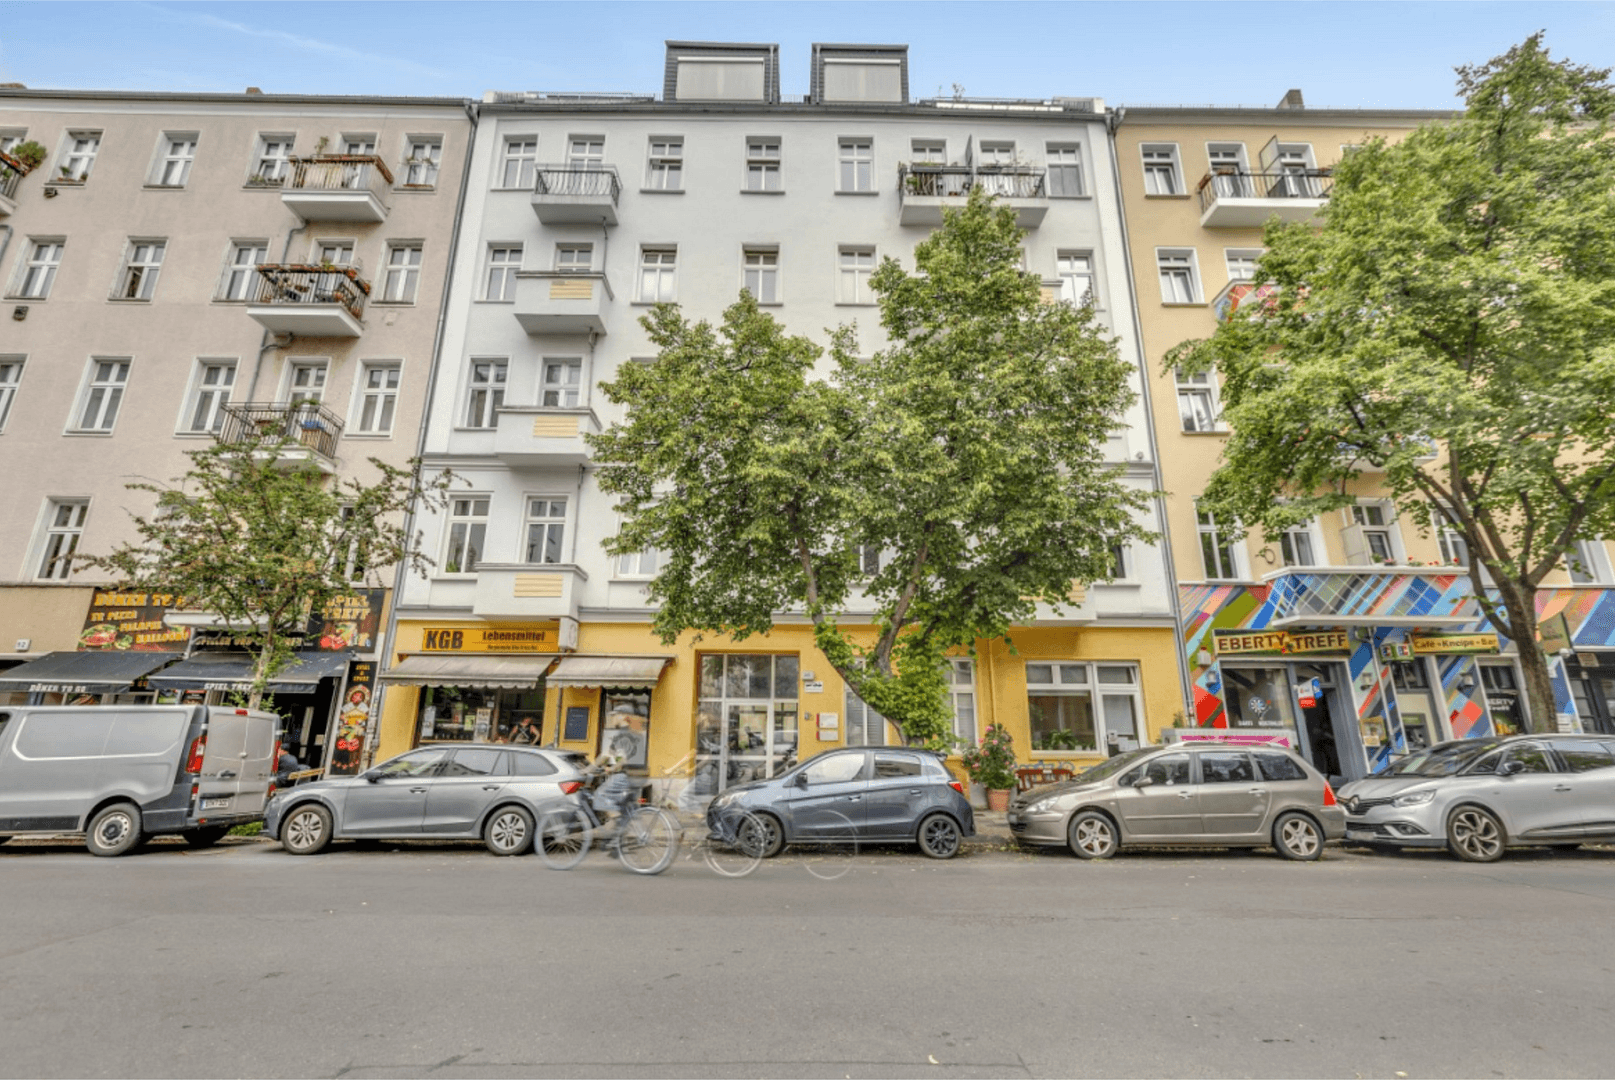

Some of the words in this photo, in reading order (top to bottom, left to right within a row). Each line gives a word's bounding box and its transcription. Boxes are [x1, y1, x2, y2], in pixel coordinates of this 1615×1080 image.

[94, 591, 147, 606] DÖNER
[106, 610, 137, 620] PIZZA
[322, 607, 371, 620] TREFF
[119, 620, 162, 631] FALAFEL
[425, 630, 464, 649] KGB
[482, 631, 545, 641] Lebensmittel
[1218, 634, 1286, 651] EBERTY
[1294, 634, 1347, 649] TREFF
[1413, 639, 1437, 649] Café
[1442, 639, 1475, 649] Kneipe
[1480, 637, 1498, 646] Bar
[28, 683, 59, 692] DÖNER
[204, 683, 229, 691] SPIEL
[231, 683, 256, 691] TREF
